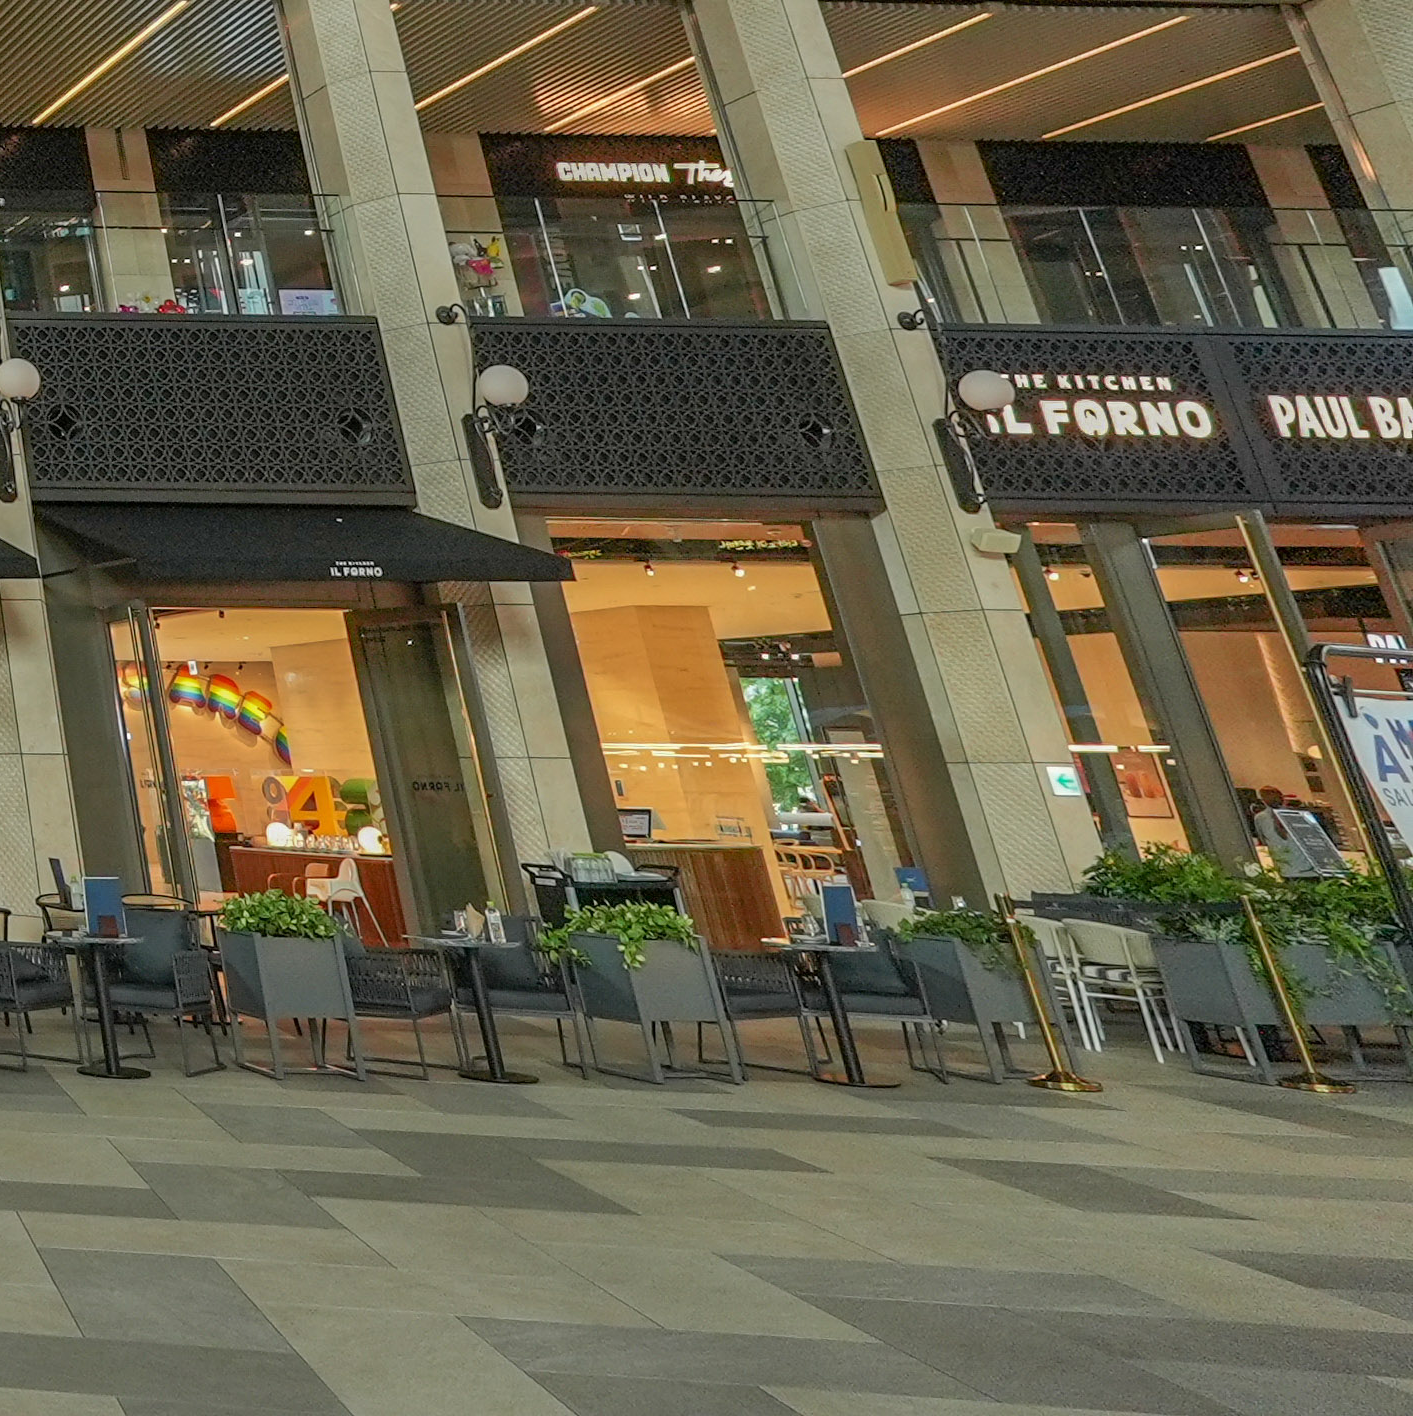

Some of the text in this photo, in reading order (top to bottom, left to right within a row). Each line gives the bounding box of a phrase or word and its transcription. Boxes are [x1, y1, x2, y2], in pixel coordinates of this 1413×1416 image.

[557, 162, 670, 182] CHAMPION
[1057, 374, 1172, 391] KITCHEN
[1039, 398, 1212, 438] FORNO
[1268, 395, 1370, 438] PAUL
[330, 566, 383, 577] IL FORNO
